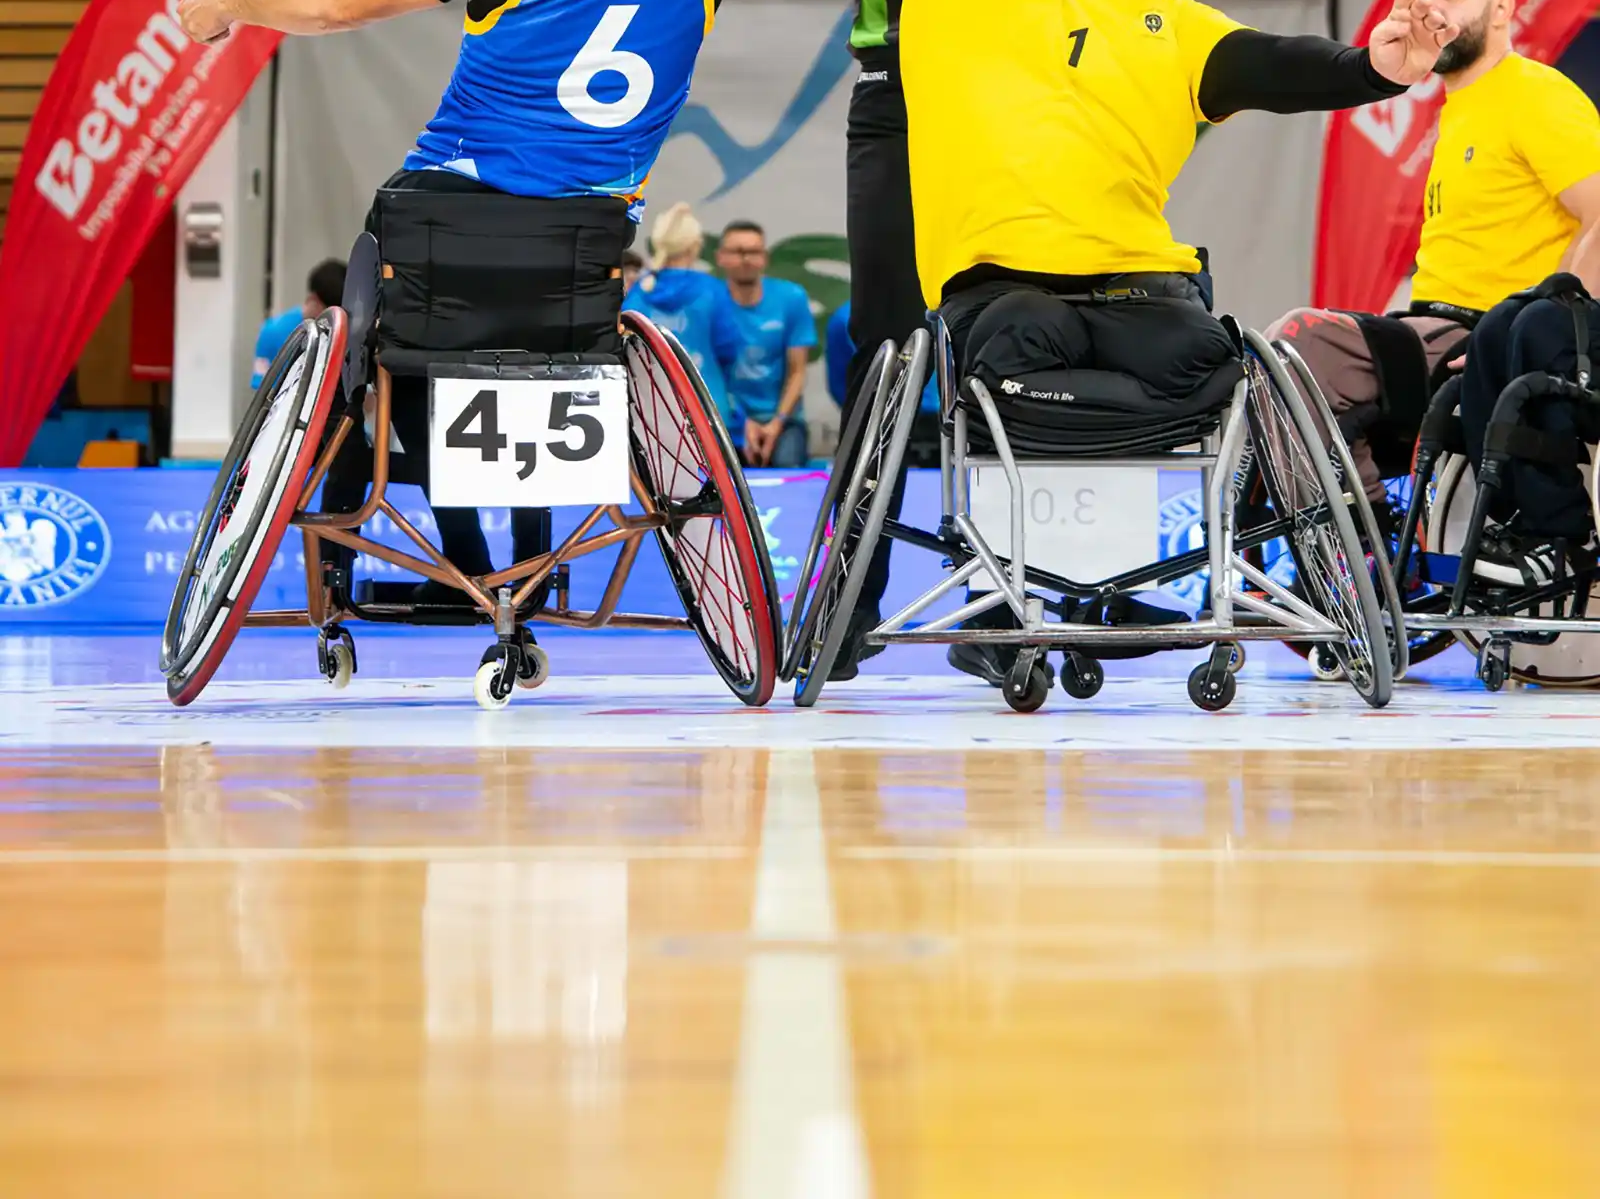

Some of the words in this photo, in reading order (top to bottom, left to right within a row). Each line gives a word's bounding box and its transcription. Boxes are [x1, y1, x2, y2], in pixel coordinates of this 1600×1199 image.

[556, 4, 655, 129] 6
[1067, 27, 1089, 68] 1
[445, 389, 605, 481] 4,5
